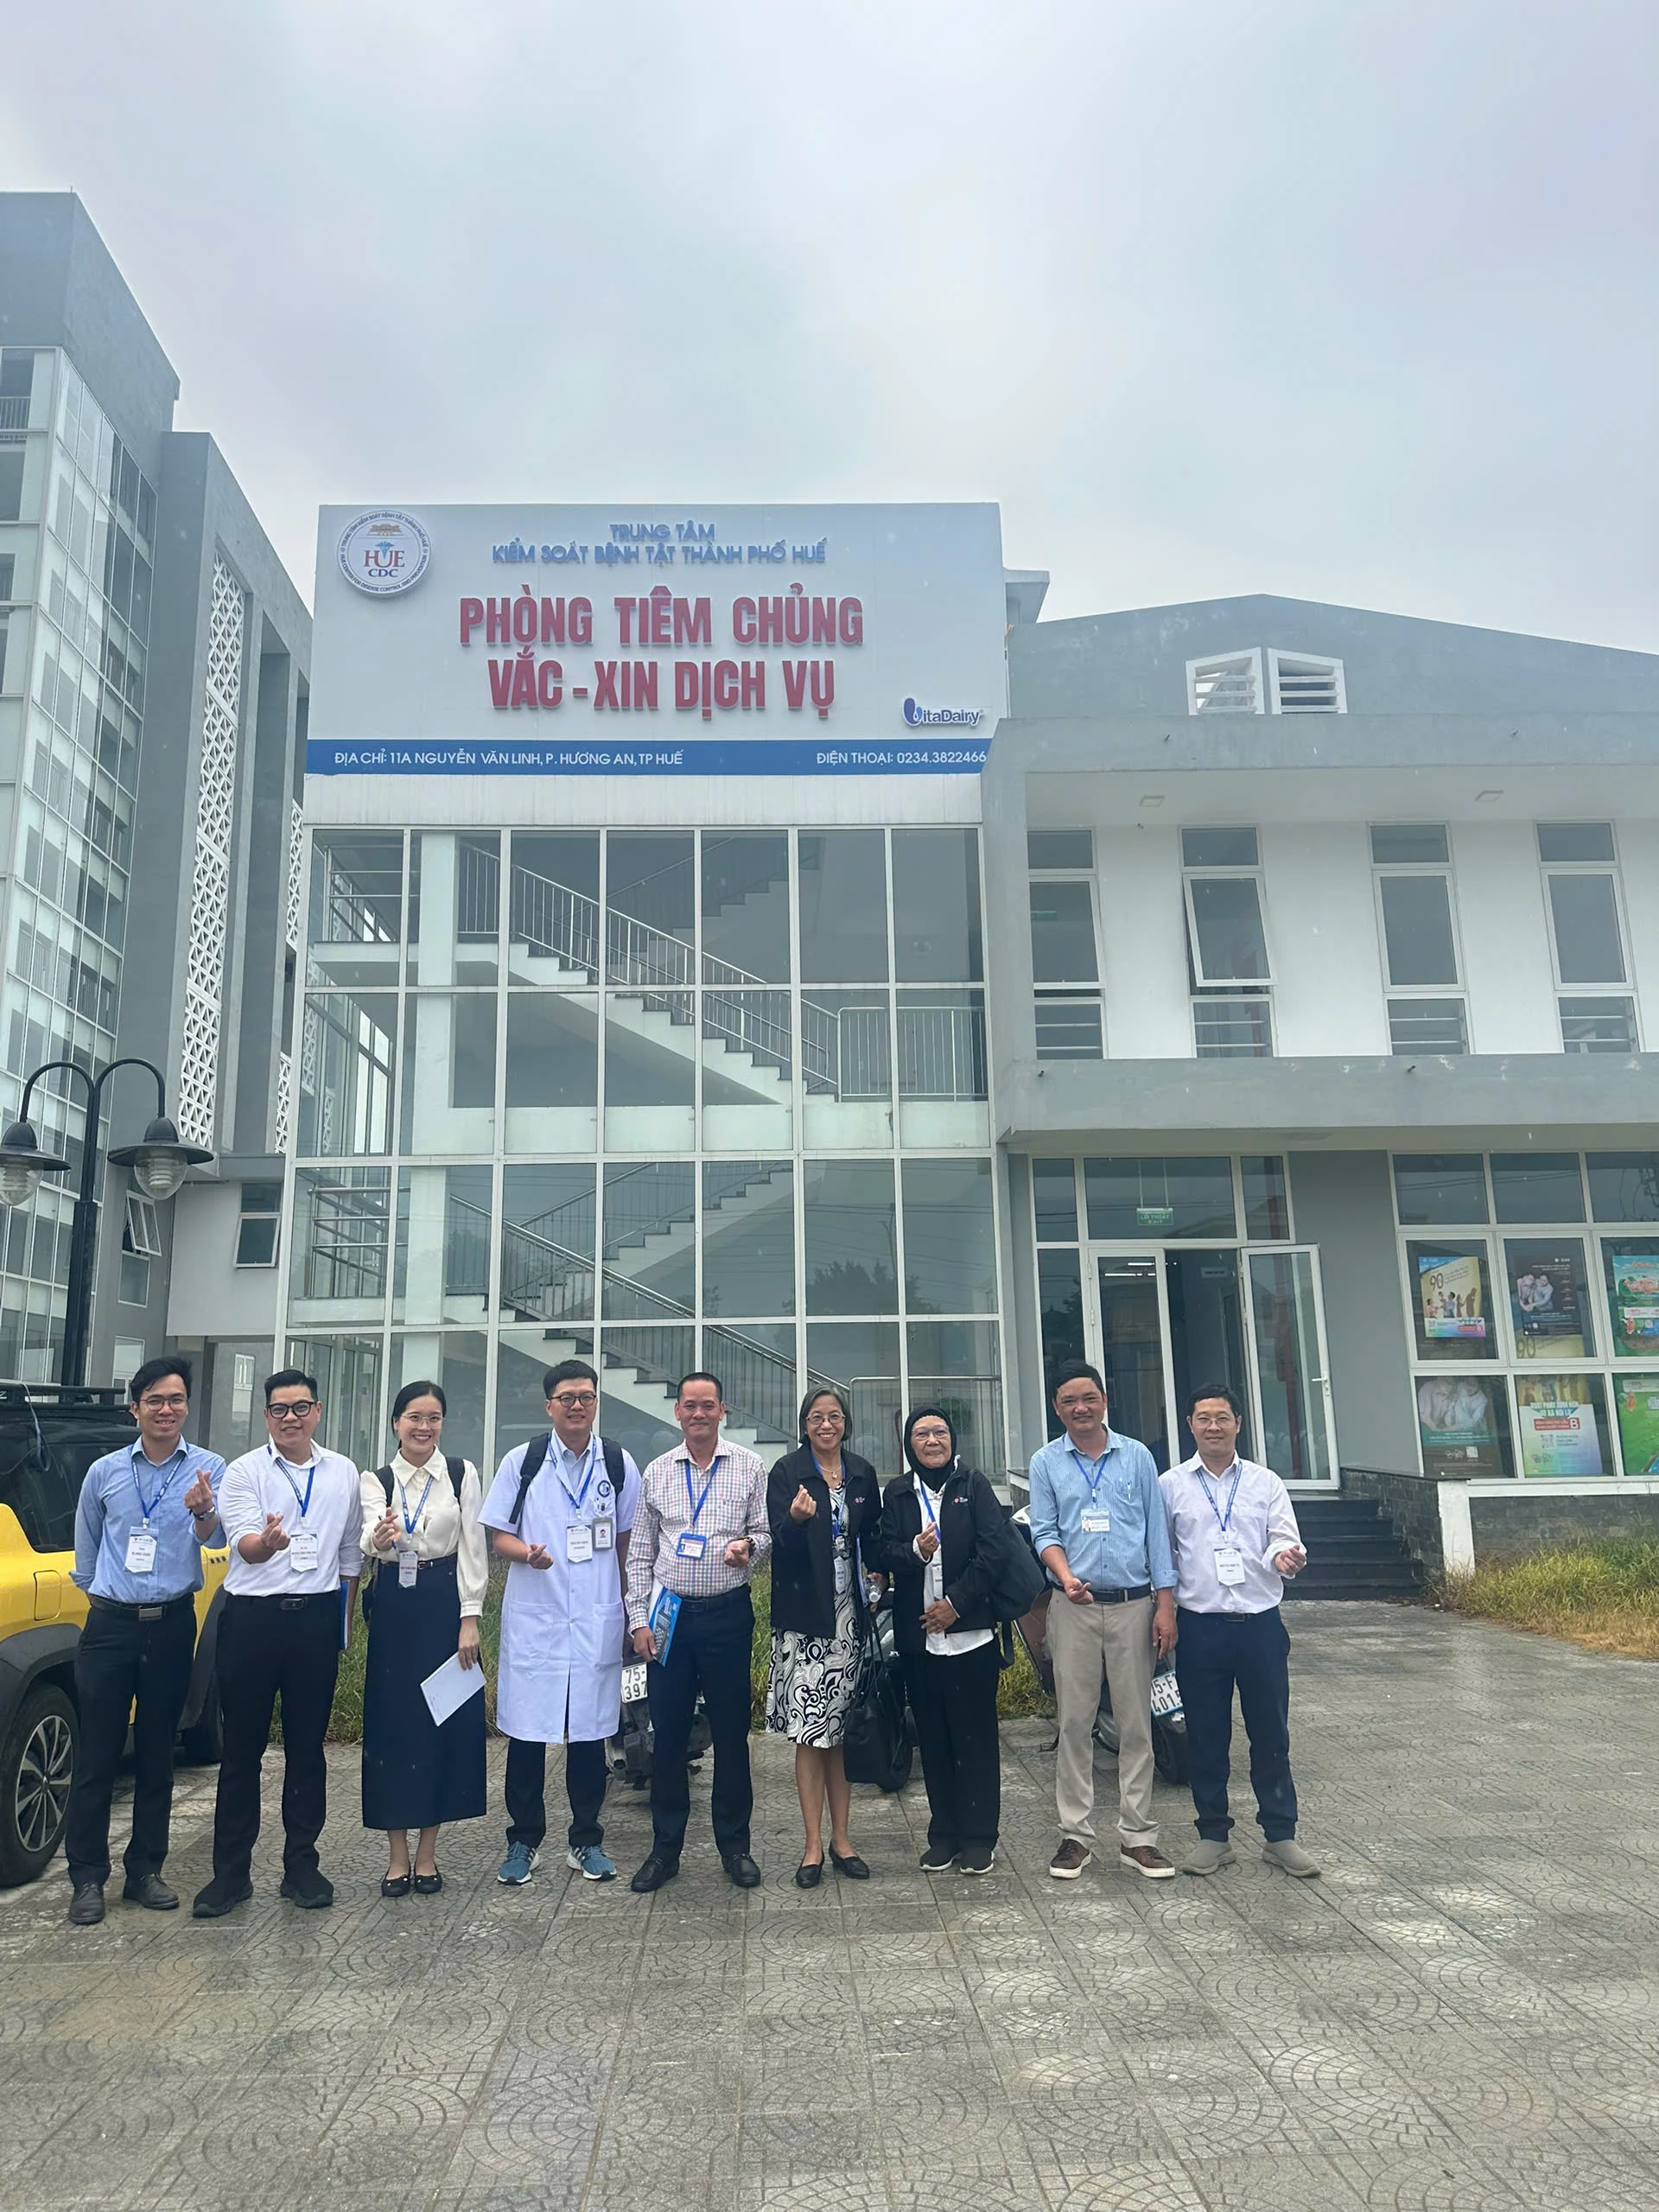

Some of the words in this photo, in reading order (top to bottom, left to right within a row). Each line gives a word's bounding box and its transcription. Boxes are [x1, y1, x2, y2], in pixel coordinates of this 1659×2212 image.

[609, 524, 671, 541] TRUNG
[676, 519, 715, 541] TÂM
[364, 550, 405, 568] HUE
[492, 537, 536, 563] KIỂM
[540, 540, 589, 563] SOÁT
[594, 542, 639, 567] BỆNH
[645, 542, 676, 567] TẬT
[682, 540, 743, 563] THÀNH
[747, 538, 786, 563] PHỐ
[792, 537, 828, 563] HUẾ
[368, 569, 399, 577] CDC
[460, 584, 594, 645] PHÒNG
[613, 586, 712, 645] TIÊM
[733, 582, 863, 645] CHỦNG
[674, 659, 766, 719] DỊCH
[782, 660, 836, 719] VỤ
[334, 752, 359, 766] ĐỊA
[359, 748, 387, 764] CHỈ:
[390, 752, 412, 764] 11A
[415, 748, 476, 765] NGUYỄN
[480, 750, 509, 765] VĂN
[512, 753, 543, 766] LINH,
[560, 751, 610, 766] HƯƠNG
[613, 753, 637, 766] AN,
[638, 753, 653, 765] TP
[656, 749, 684, 765] HUẾ
[817, 750, 848, 766] ĐIỆN
[850, 753, 893, 766] THOẠI:
[896, 751, 987, 764] 0234.3822466
[1429, 1273, 1444, 1292] 90
[1569, 1418, 1579, 1430] B
[624, 1681, 647, 1700] 397
